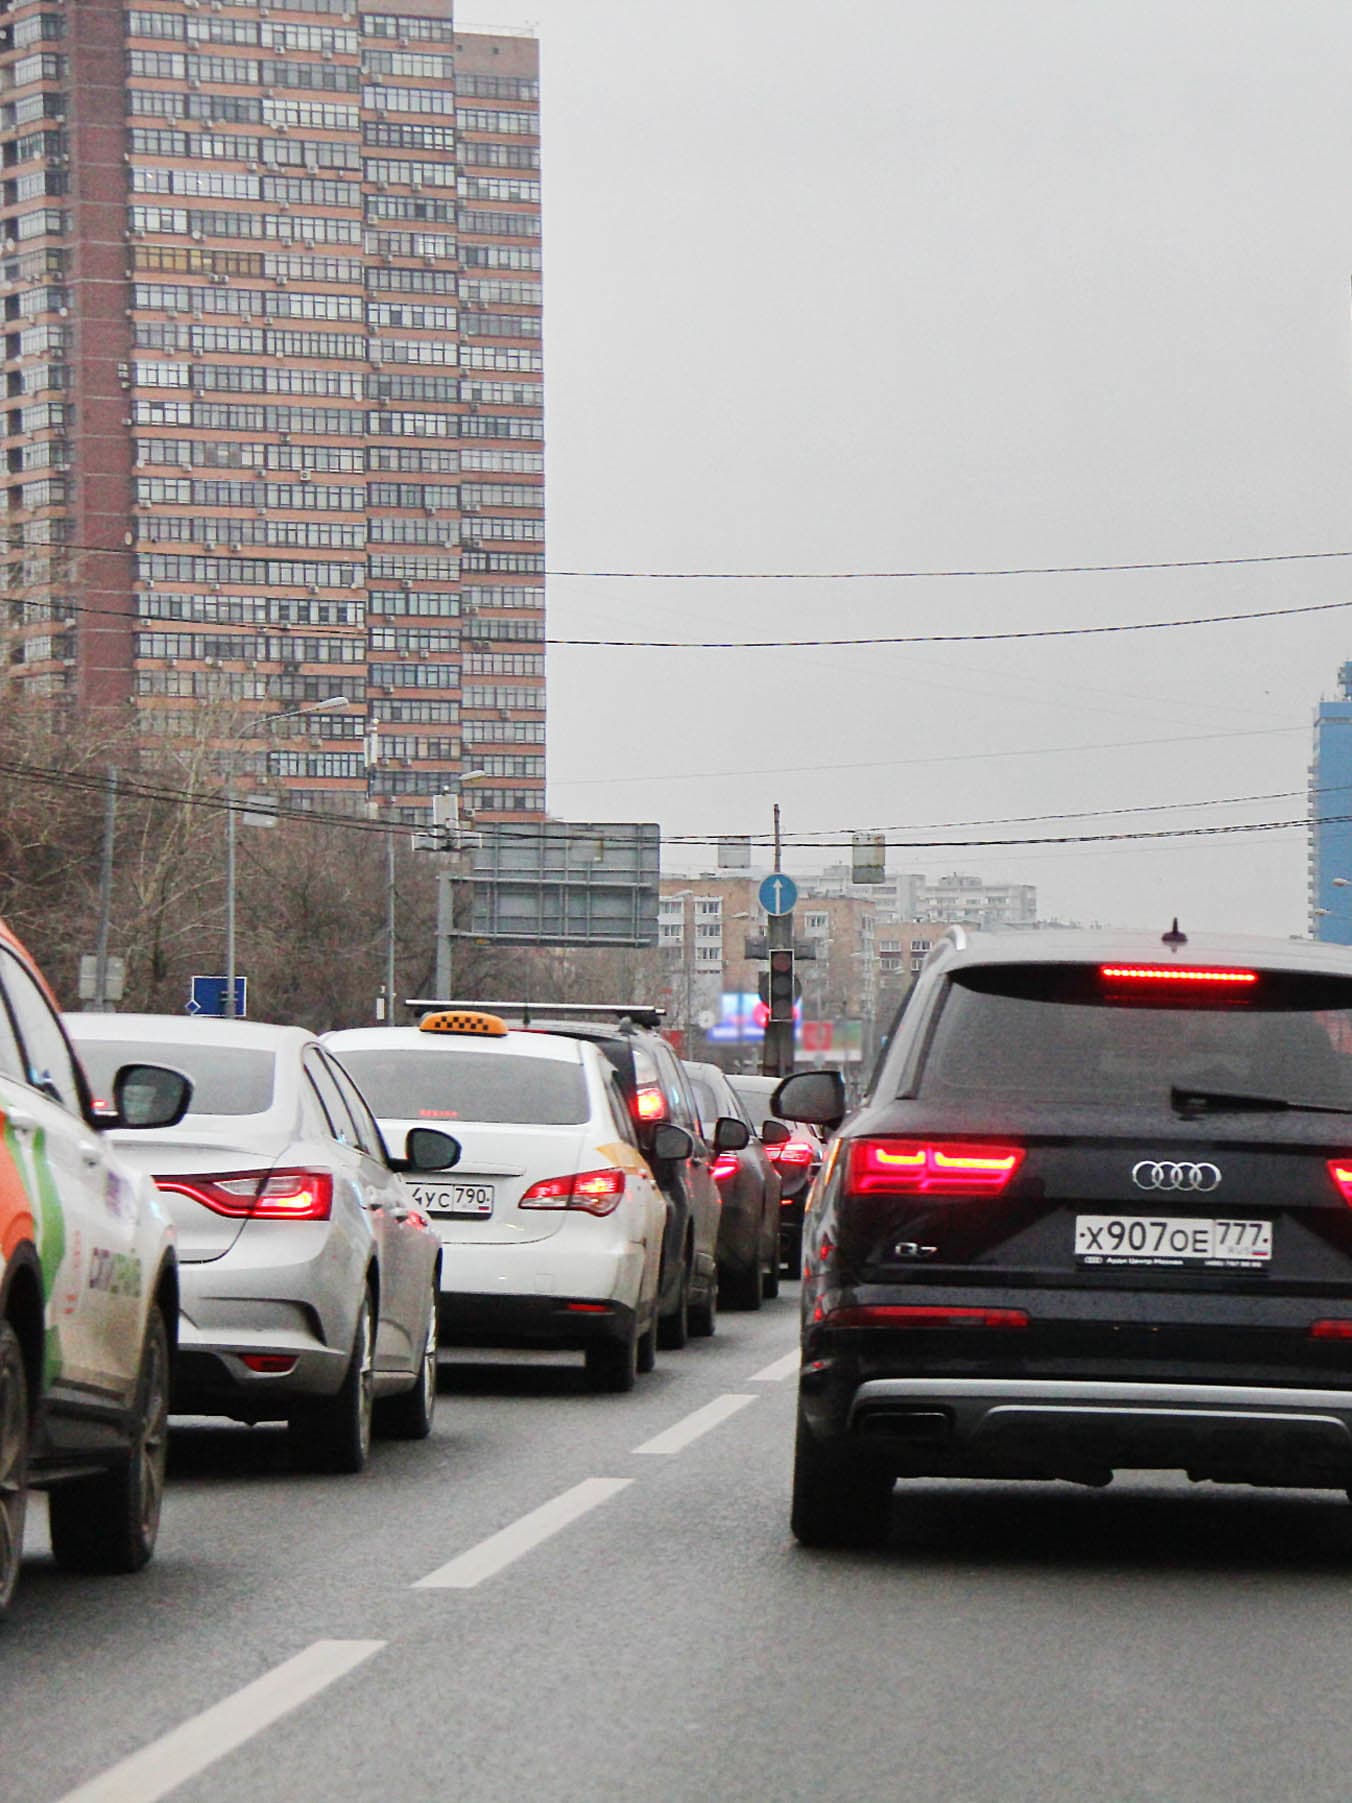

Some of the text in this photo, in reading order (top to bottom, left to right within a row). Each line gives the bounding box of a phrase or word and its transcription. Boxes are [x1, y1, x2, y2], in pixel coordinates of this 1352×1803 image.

[456, 1188, 486, 1204] 790
[1086, 1221, 1263, 1253] Х907ОЕ 777
[895, 1242, 938, 1257] Q7
